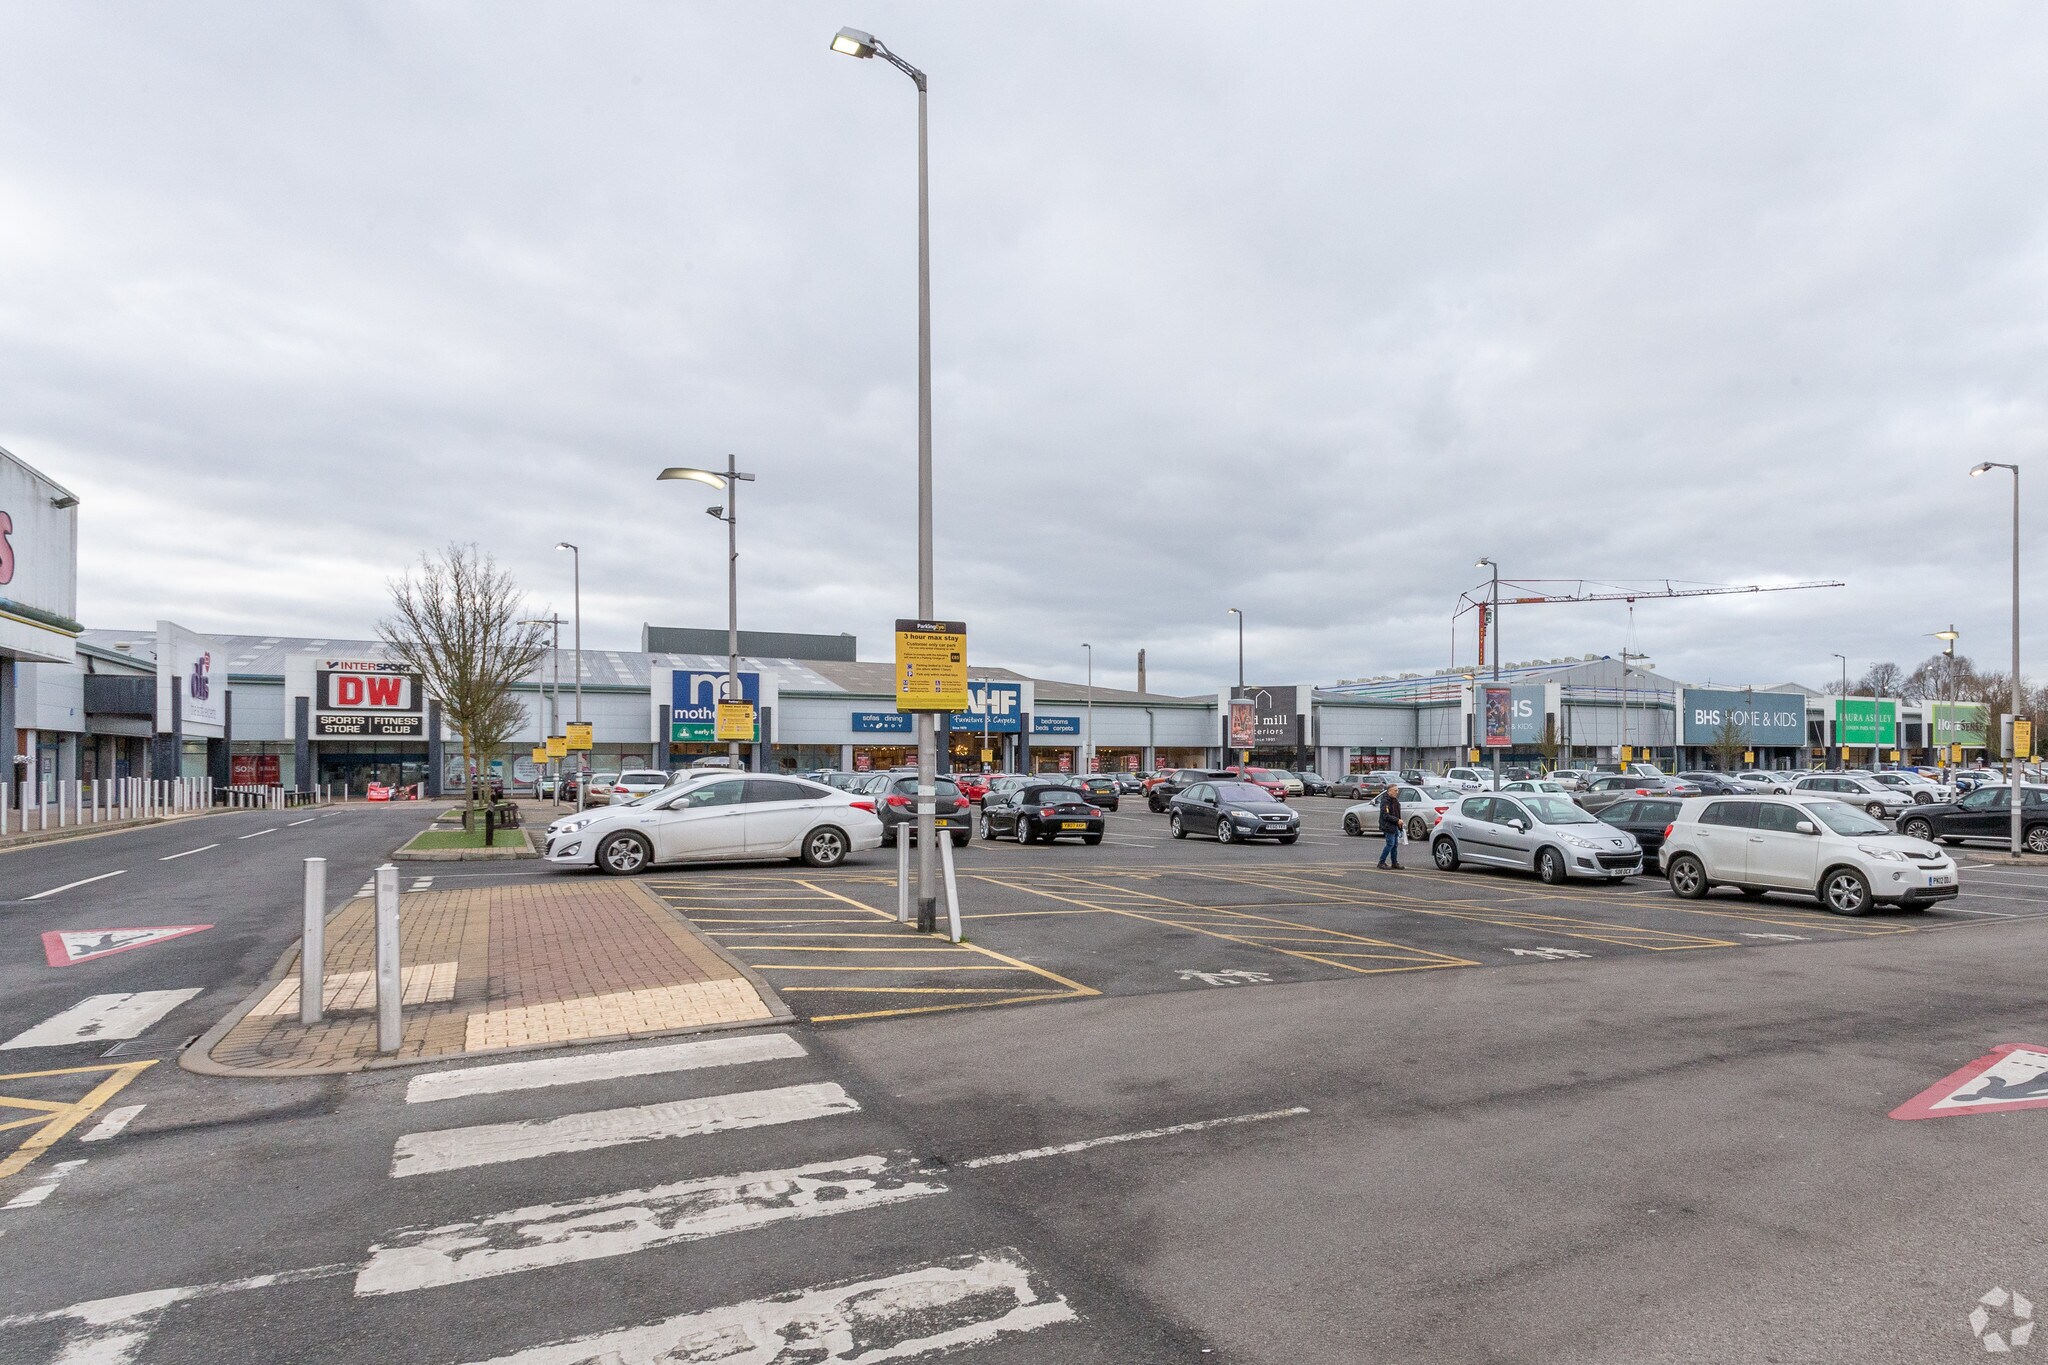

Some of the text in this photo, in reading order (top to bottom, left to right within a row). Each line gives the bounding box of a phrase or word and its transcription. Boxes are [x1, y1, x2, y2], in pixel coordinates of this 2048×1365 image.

[341, 662, 411, 672] INTERSPORT
[338, 676, 402, 706] DW
[1511, 700, 1533, 718] HS
[374, 717, 418, 725] FITNESS
[884, 714, 902, 723] dining
[952, 714, 984, 723] Furniture
[993, 716, 1016, 725] Carpets
[1263, 715, 1288, 725] mill
[1695, 710, 1797, 727] BHS HOME & KIDS
[1840, 713, 1863, 722] LAURA
